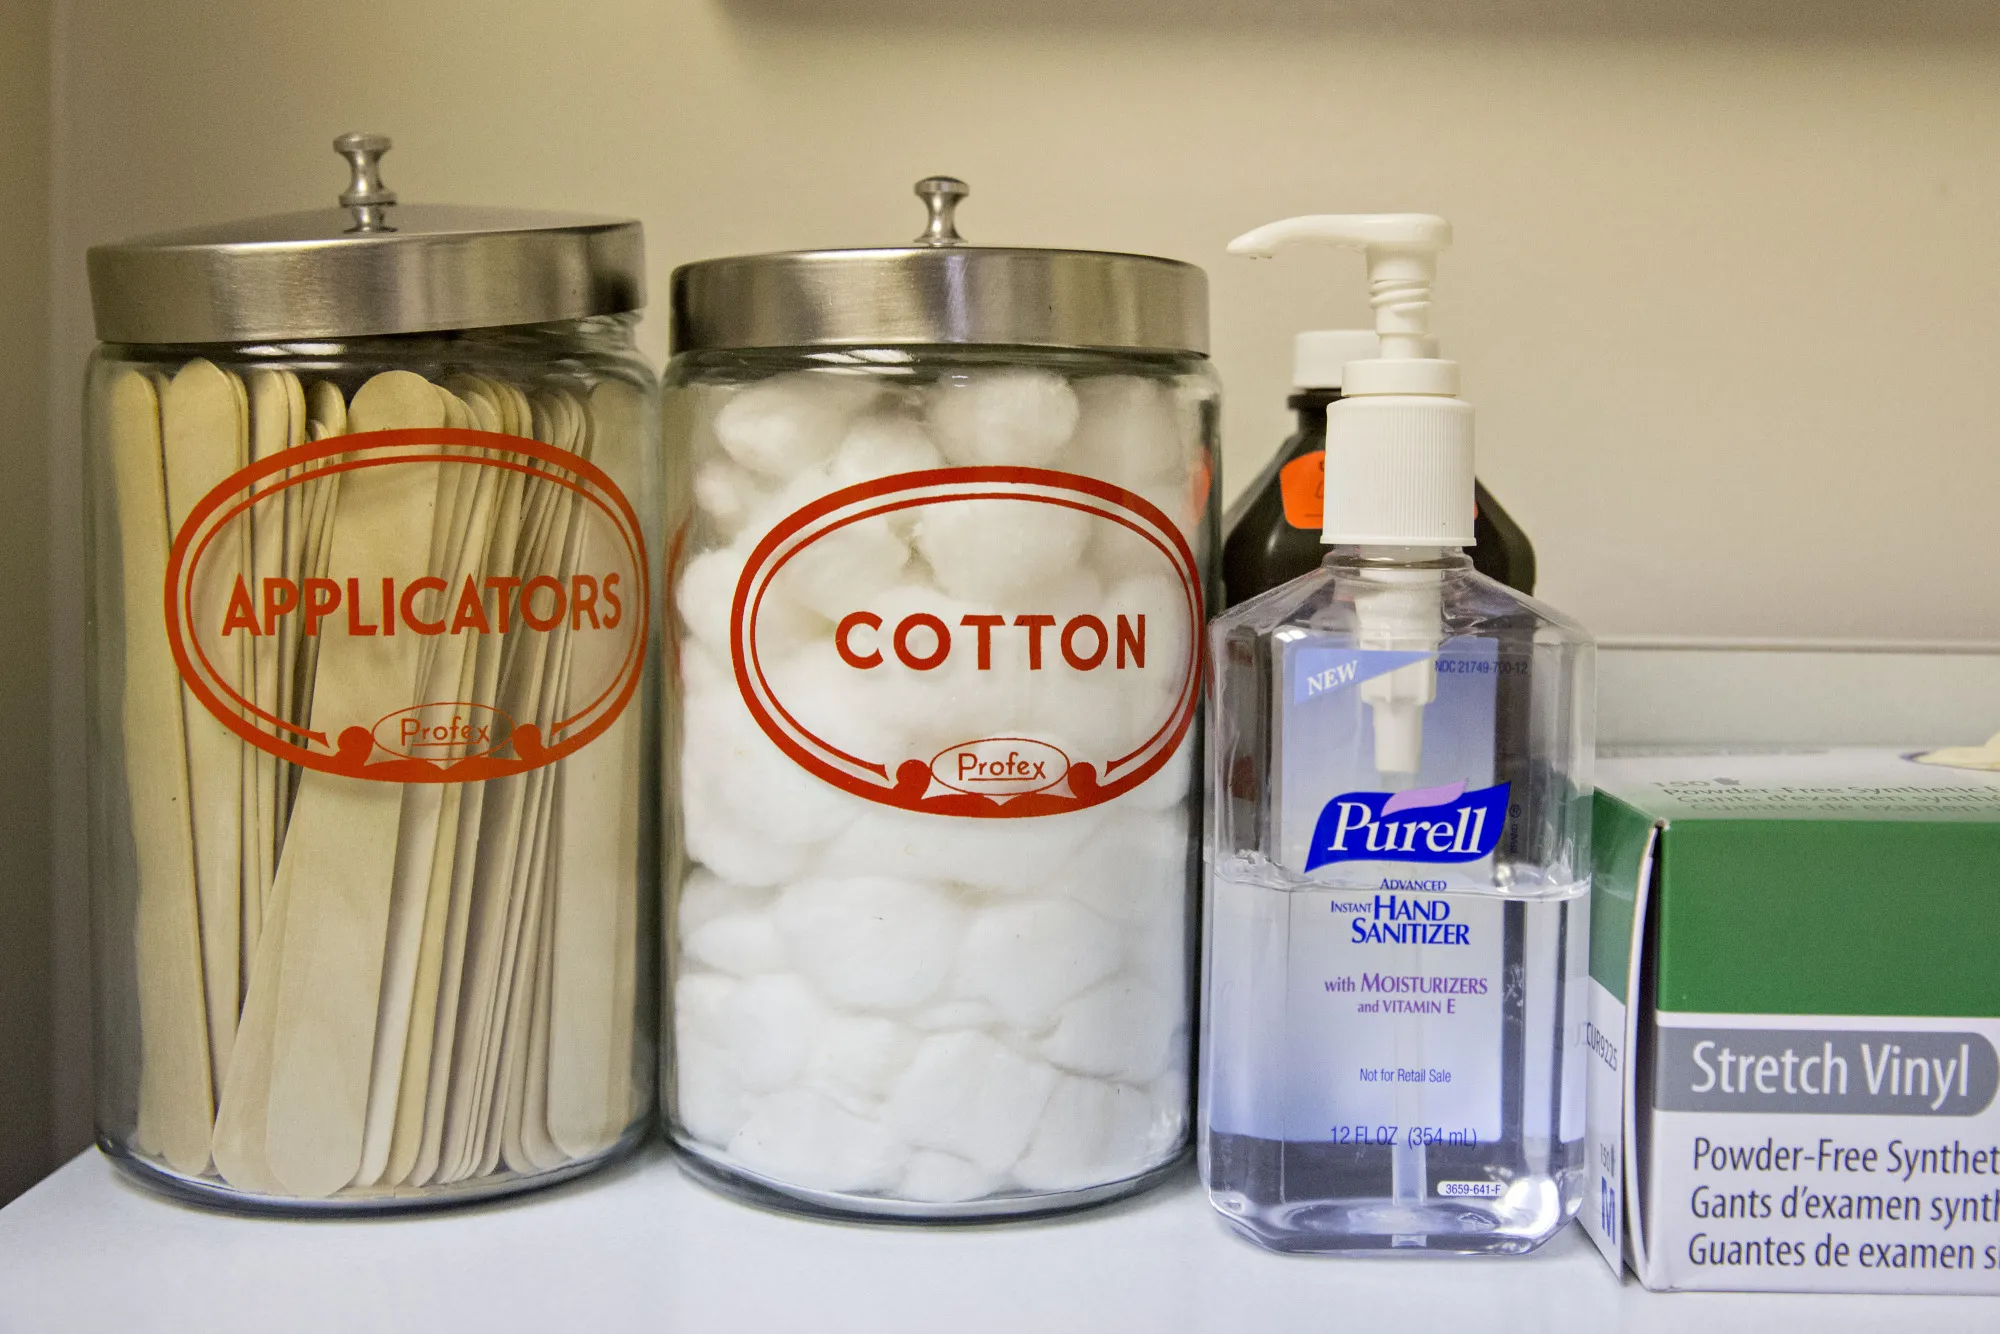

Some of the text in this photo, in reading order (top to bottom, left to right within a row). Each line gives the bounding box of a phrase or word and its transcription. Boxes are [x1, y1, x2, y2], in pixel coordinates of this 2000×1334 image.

[221, 572, 622, 637] APPLICATORS
[834, 610, 1146, 672] COTTON
[1306, 658, 1359, 696] NEW
[1435, 660, 1456, 674] NDC
[401, 715, 490, 746] Profex
[957, 750, 1047, 780] Profex
[1327, 801, 1488, 854] Purell
[1379, 877, 1448, 892] ADVANCED
[1330, 895, 1451, 921] INSTANT HAND
[1351, 917, 1471, 945] SANITIZER
[1324, 973, 1488, 995] with MOISTURIZERS
[1357, 998, 1456, 1015] and VITAMIN E
[1586, 1021, 1617, 1071] CUR9225
[1359, 1068, 1452, 1083] Not for Retail Sale
[1691, 1040, 1970, 1112] Stretch Vinyl
[1330, 1125, 1477, 1151] 12 FL OZ (354 mL)
[1693, 1137, 2000, 1182] Powder-Free Synthet
[1601, 1175, 1616, 1244] M
[1691, 1185, 1772, 1219] Gants
[1781, 1185, 1921, 1221] d'examen
[1688, 1232, 1805, 1267] Guantes
[1814, 1232, 1850, 1267] de
[1858, 1242, 1975, 1270] examen
